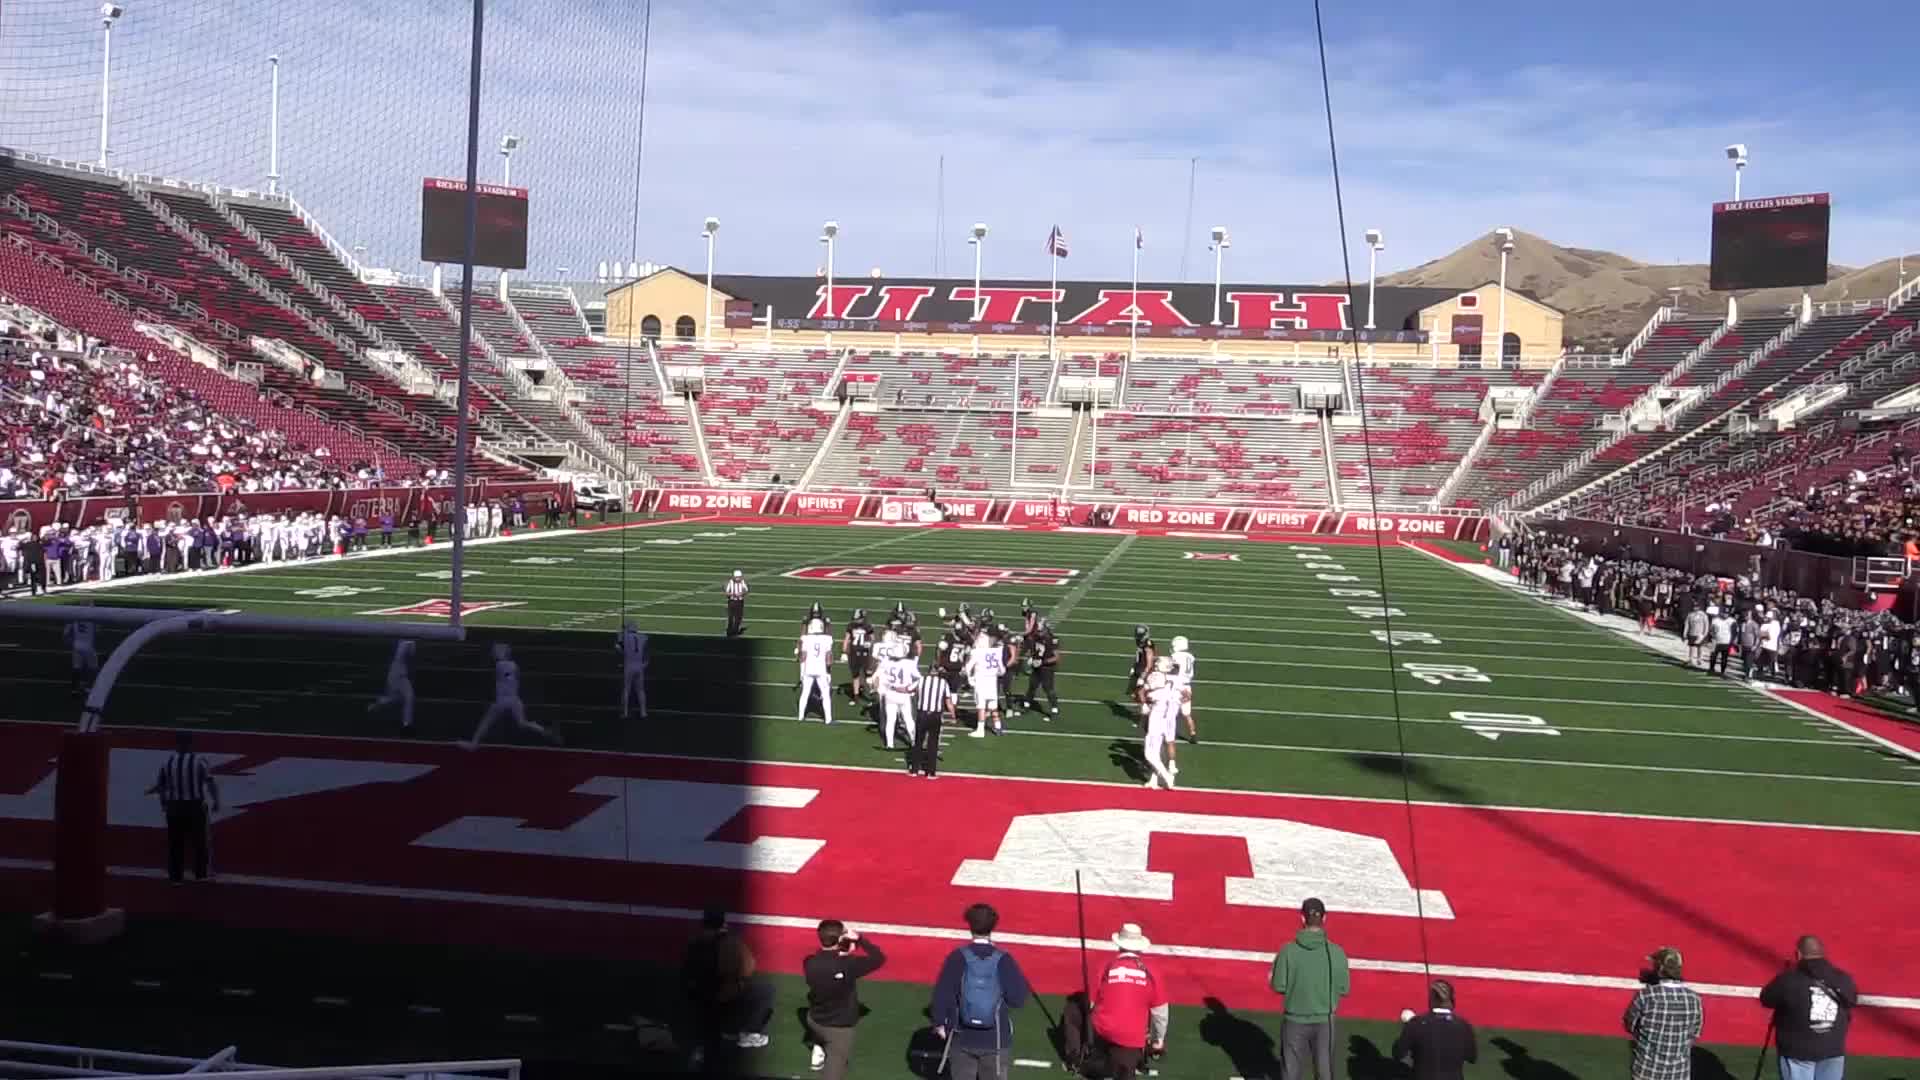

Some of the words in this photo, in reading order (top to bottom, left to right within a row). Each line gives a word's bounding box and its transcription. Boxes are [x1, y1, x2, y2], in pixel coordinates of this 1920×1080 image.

[806, 284, 1354, 330] UTAH
[669, 494, 702, 508] RED
[705, 495, 752, 509] ZONE
[1128, 509, 1163, 523] RED
[1167, 511, 1216, 525] ZONE
[1356, 517, 1393, 531] RED
[1397, 518, 1445, 534] ZONE
[813, 642, 821, 659] 9
[985, 653, 999, 670] 95
[889, 667, 904, 685] 54
[1402, 663, 1492, 685] 20
[1449, 711, 1561, 740] 10
